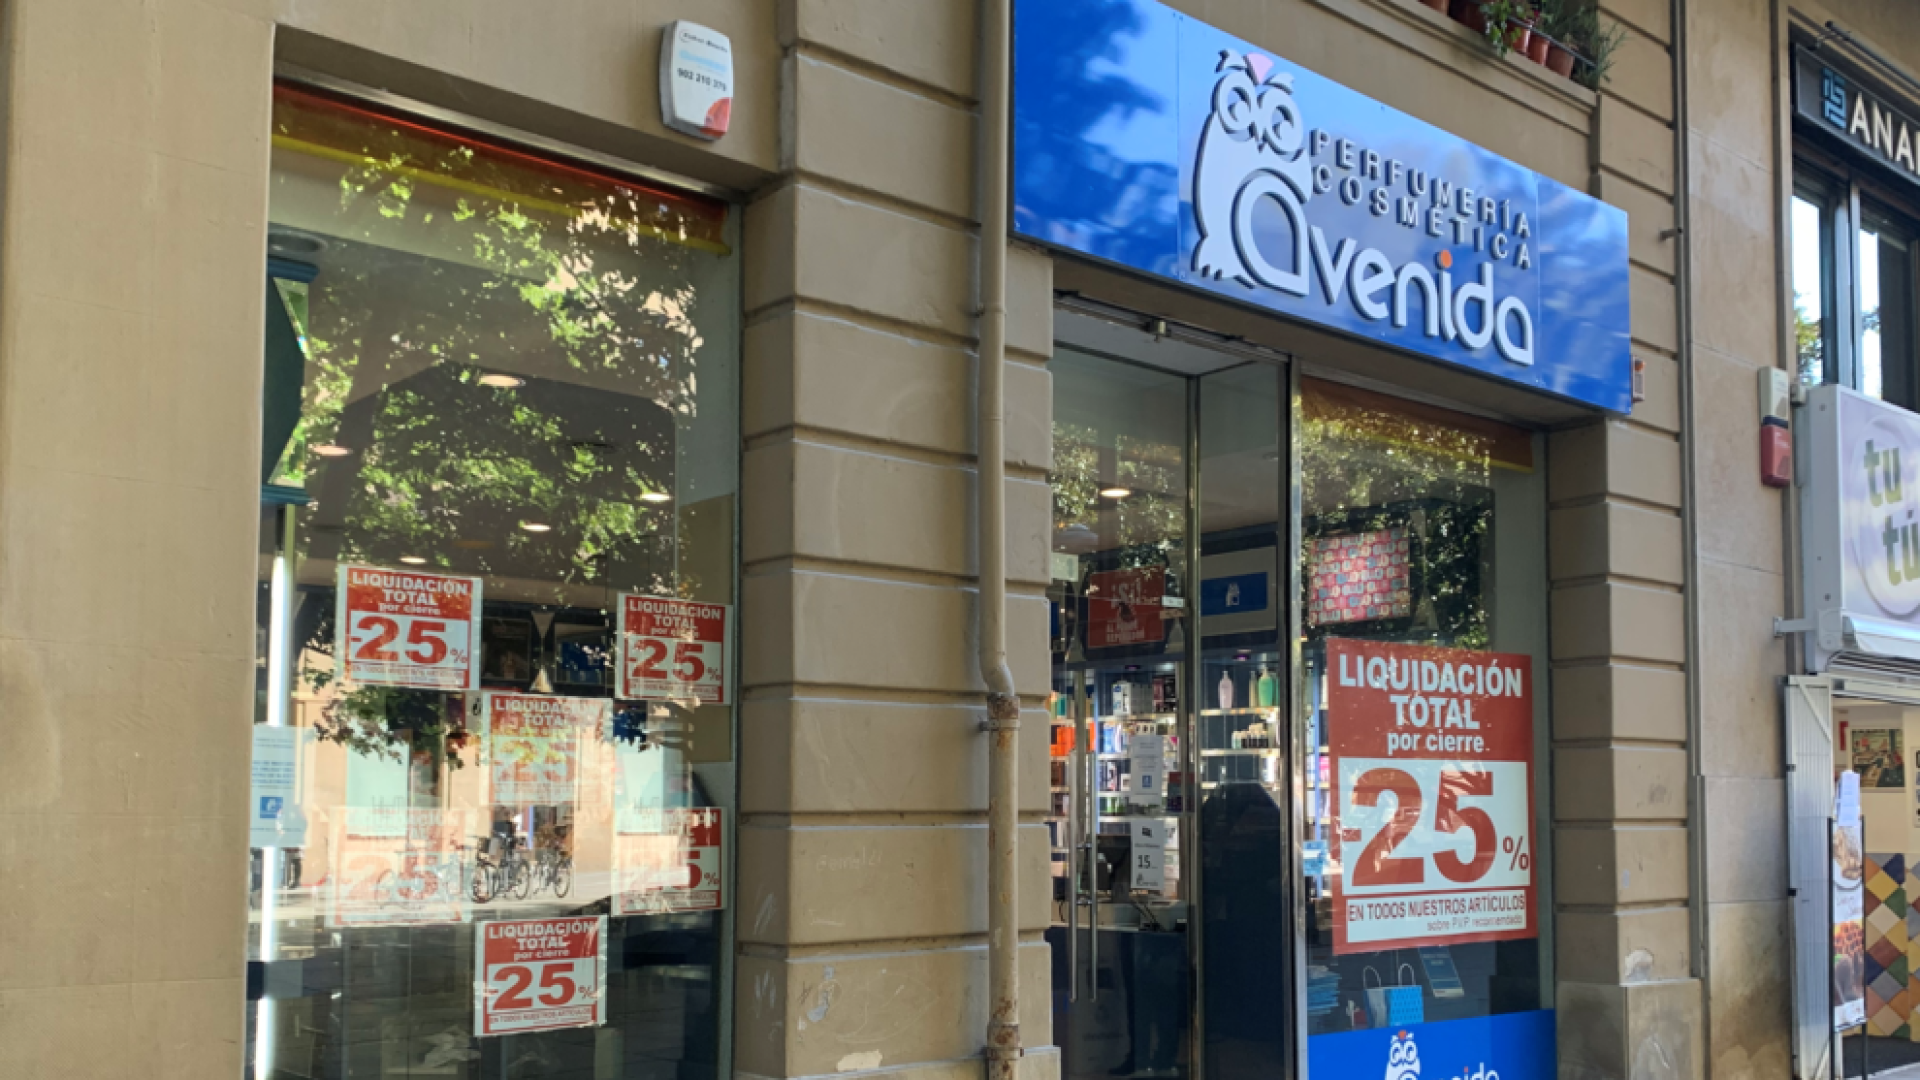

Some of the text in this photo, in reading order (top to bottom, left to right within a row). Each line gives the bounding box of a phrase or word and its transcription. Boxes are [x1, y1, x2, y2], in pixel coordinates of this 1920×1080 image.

[1849, 91, 1920, 177] ANA
[1309, 128, 1531, 239] PERFUMERÍA
[1311, 164, 1531, 270] COSMÉTICA
[1232, 167, 1534, 366] avenida
[1864, 439, 1902, 507] tu
[1883, 509, 1920, 586] tú
[352, 571, 468, 595] LIQUIDACIÓN
[382, 588, 438, 606] TOTAL
[629, 599, 720, 619] LIQUIDACIÓN
[654, 614, 697, 630] TOTAL
[1339, 653, 1523, 698] LIQUIDACIÓN
[1389, 694, 1481, 730] TOTAL
[1387, 729, 1485, 756] por cierre
[1349, 893, 1525, 921] EN TODOS NUESTROS ARTÍCULOS
[489, 919, 597, 939] LIQUIDACIÓN
[516, 935, 571, 950] TOTAL
